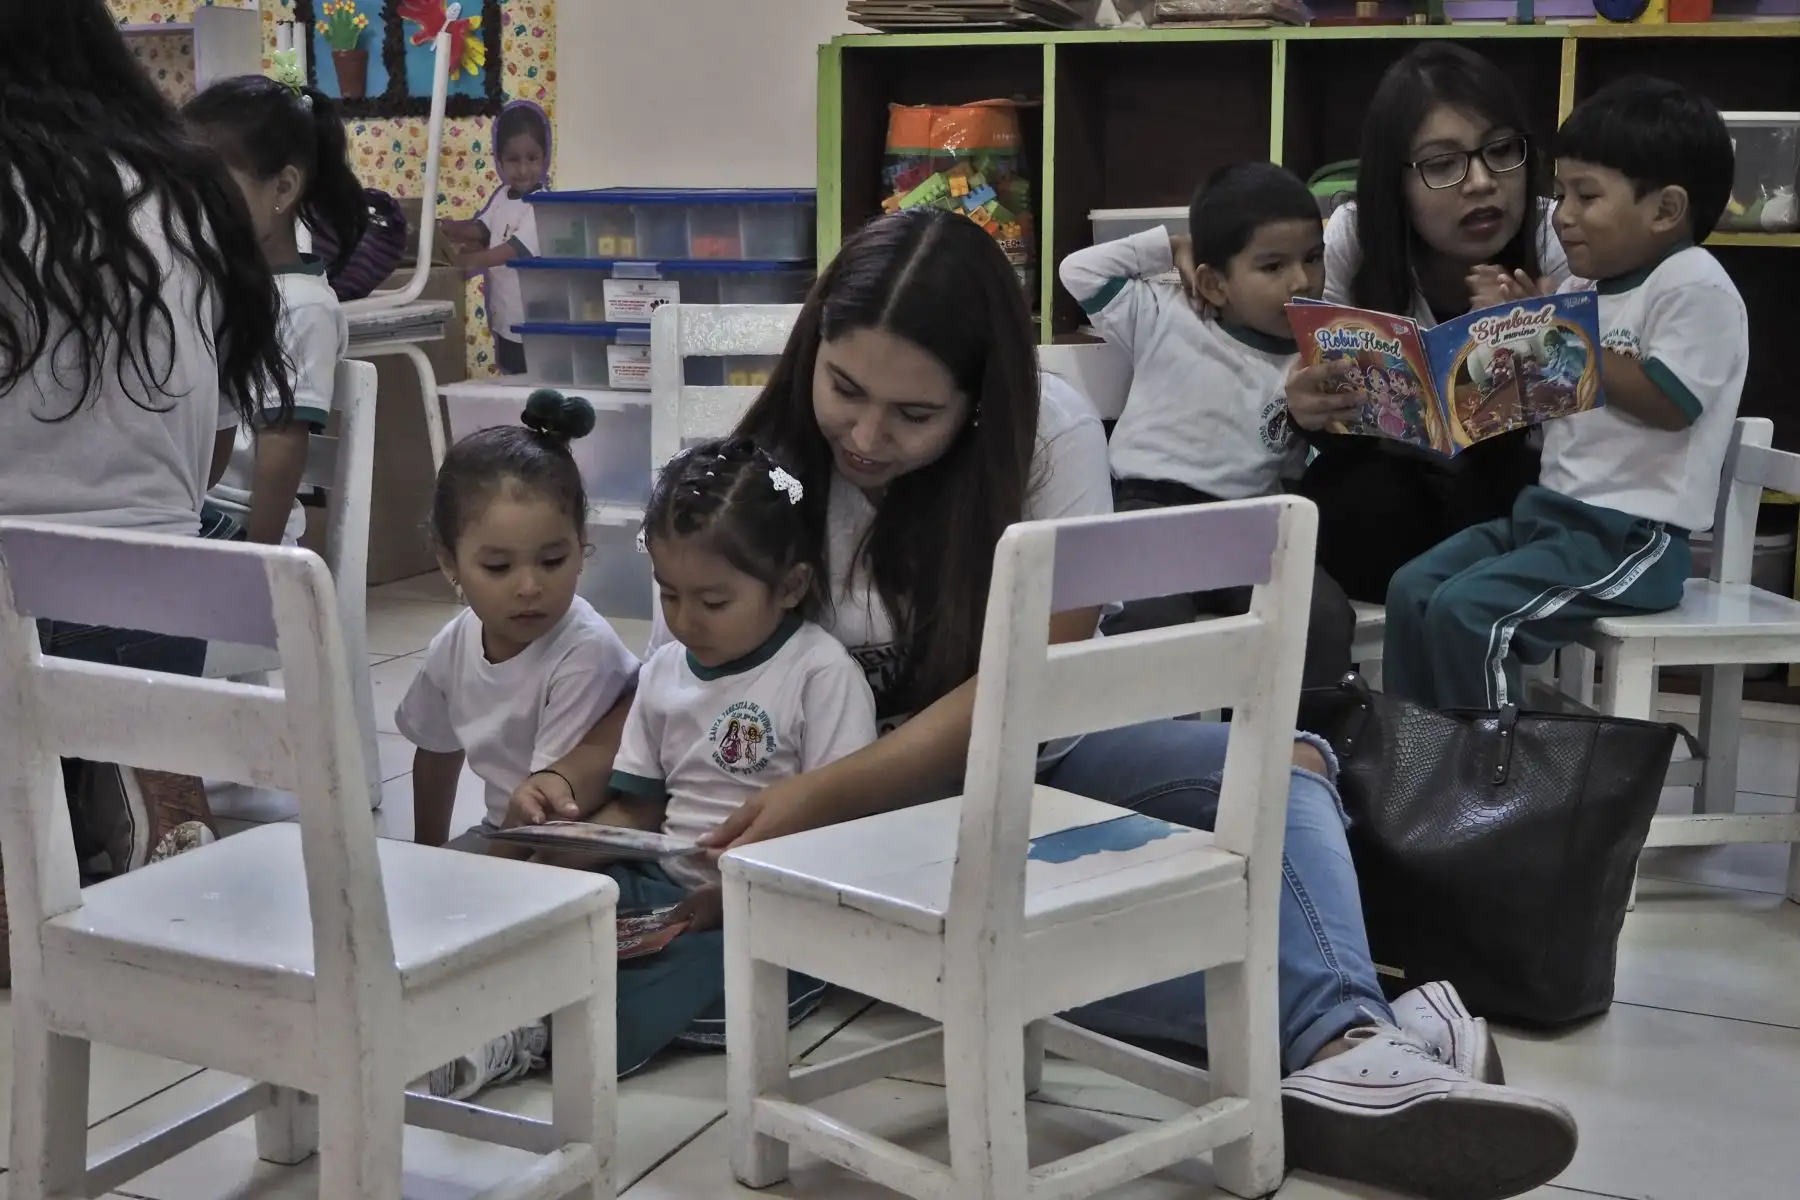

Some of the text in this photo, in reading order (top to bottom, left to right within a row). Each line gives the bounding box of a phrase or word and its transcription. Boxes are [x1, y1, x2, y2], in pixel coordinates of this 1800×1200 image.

[1471, 306, 1552, 341] Simbad
[1490, 327, 1537, 346] el marino
[1317, 327, 1401, 357] Robin Hood
[709, 718, 723, 742] SANTA
[748, 702, 760, 714] DEL
